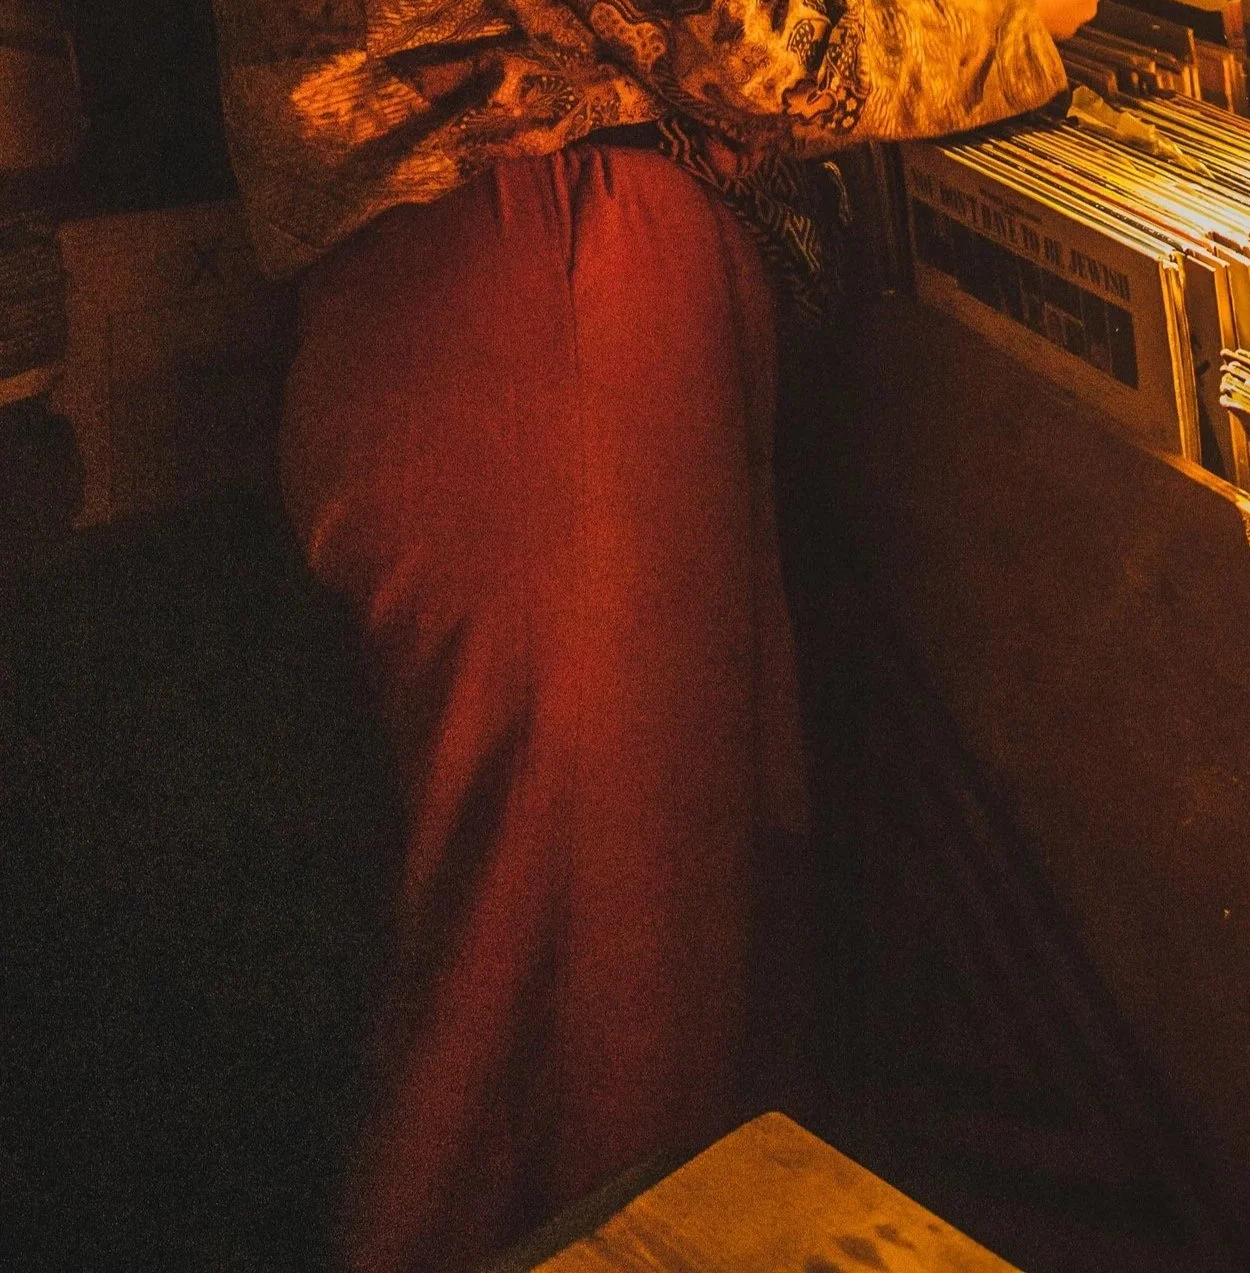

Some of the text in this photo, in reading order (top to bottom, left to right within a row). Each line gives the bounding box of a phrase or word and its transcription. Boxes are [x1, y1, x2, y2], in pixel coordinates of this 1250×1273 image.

[981, 201, 1018, 244] HAVE
[1021, 223, 1041, 254] TO
[1043, 234, 1065, 270] BE
[1070, 247, 1131, 302] JEWISH
